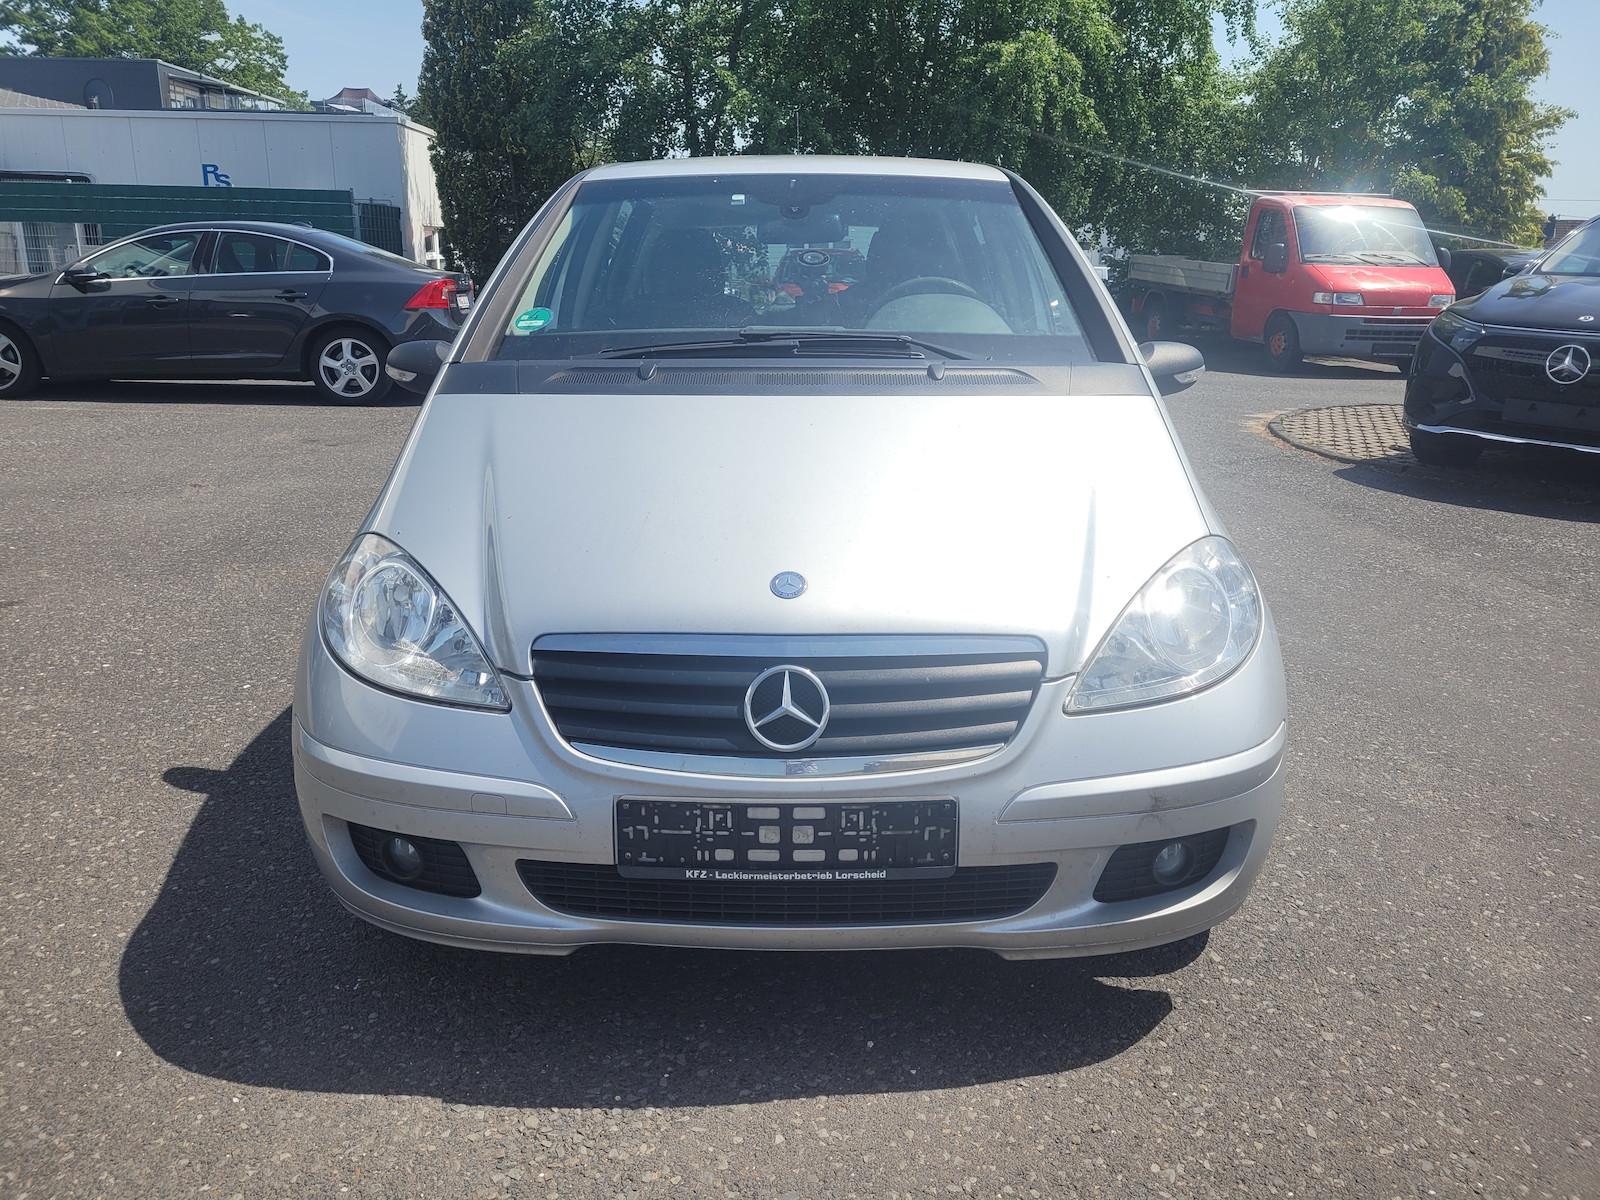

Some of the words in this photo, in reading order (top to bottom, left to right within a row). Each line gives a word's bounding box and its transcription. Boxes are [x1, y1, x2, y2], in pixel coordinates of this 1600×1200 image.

[685, 870, 707, 879] KFZ
[715, 871, 833, 880] Lackiermeisterbetrieb
[835, 869, 887, 880] Lorscheid
